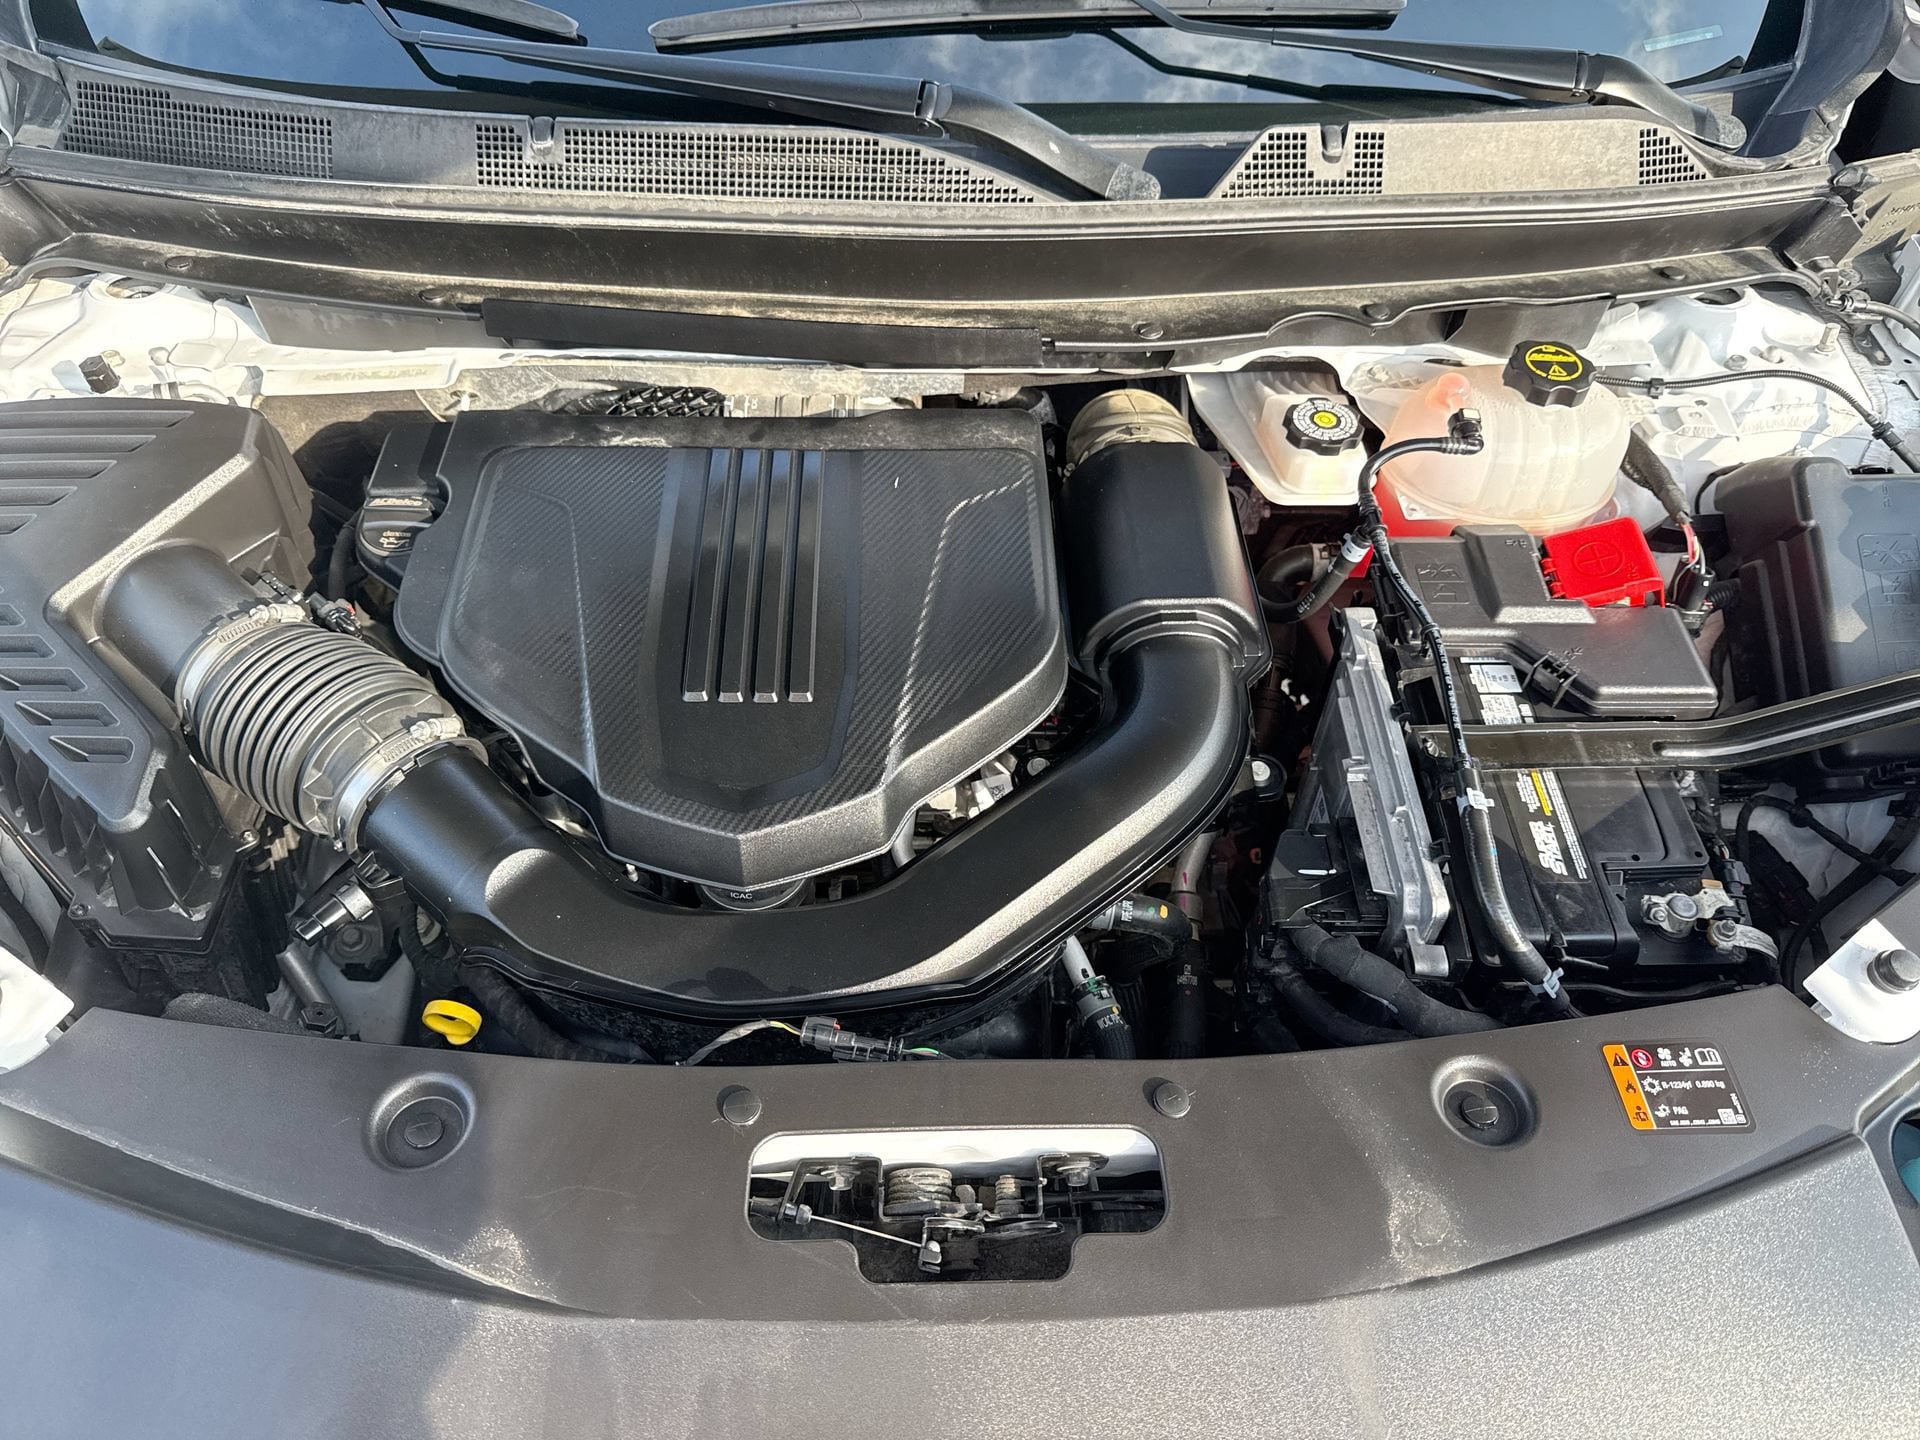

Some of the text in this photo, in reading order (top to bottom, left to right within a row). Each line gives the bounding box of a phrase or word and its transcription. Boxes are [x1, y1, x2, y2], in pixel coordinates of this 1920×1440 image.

[1529, 820, 1551, 868] SUPER
[1661, 1081, 1693, 1090] R-1234yf
[1715, 1080, 1726, 1089] kg
[1673, 1106, 1689, 1115] PAG
